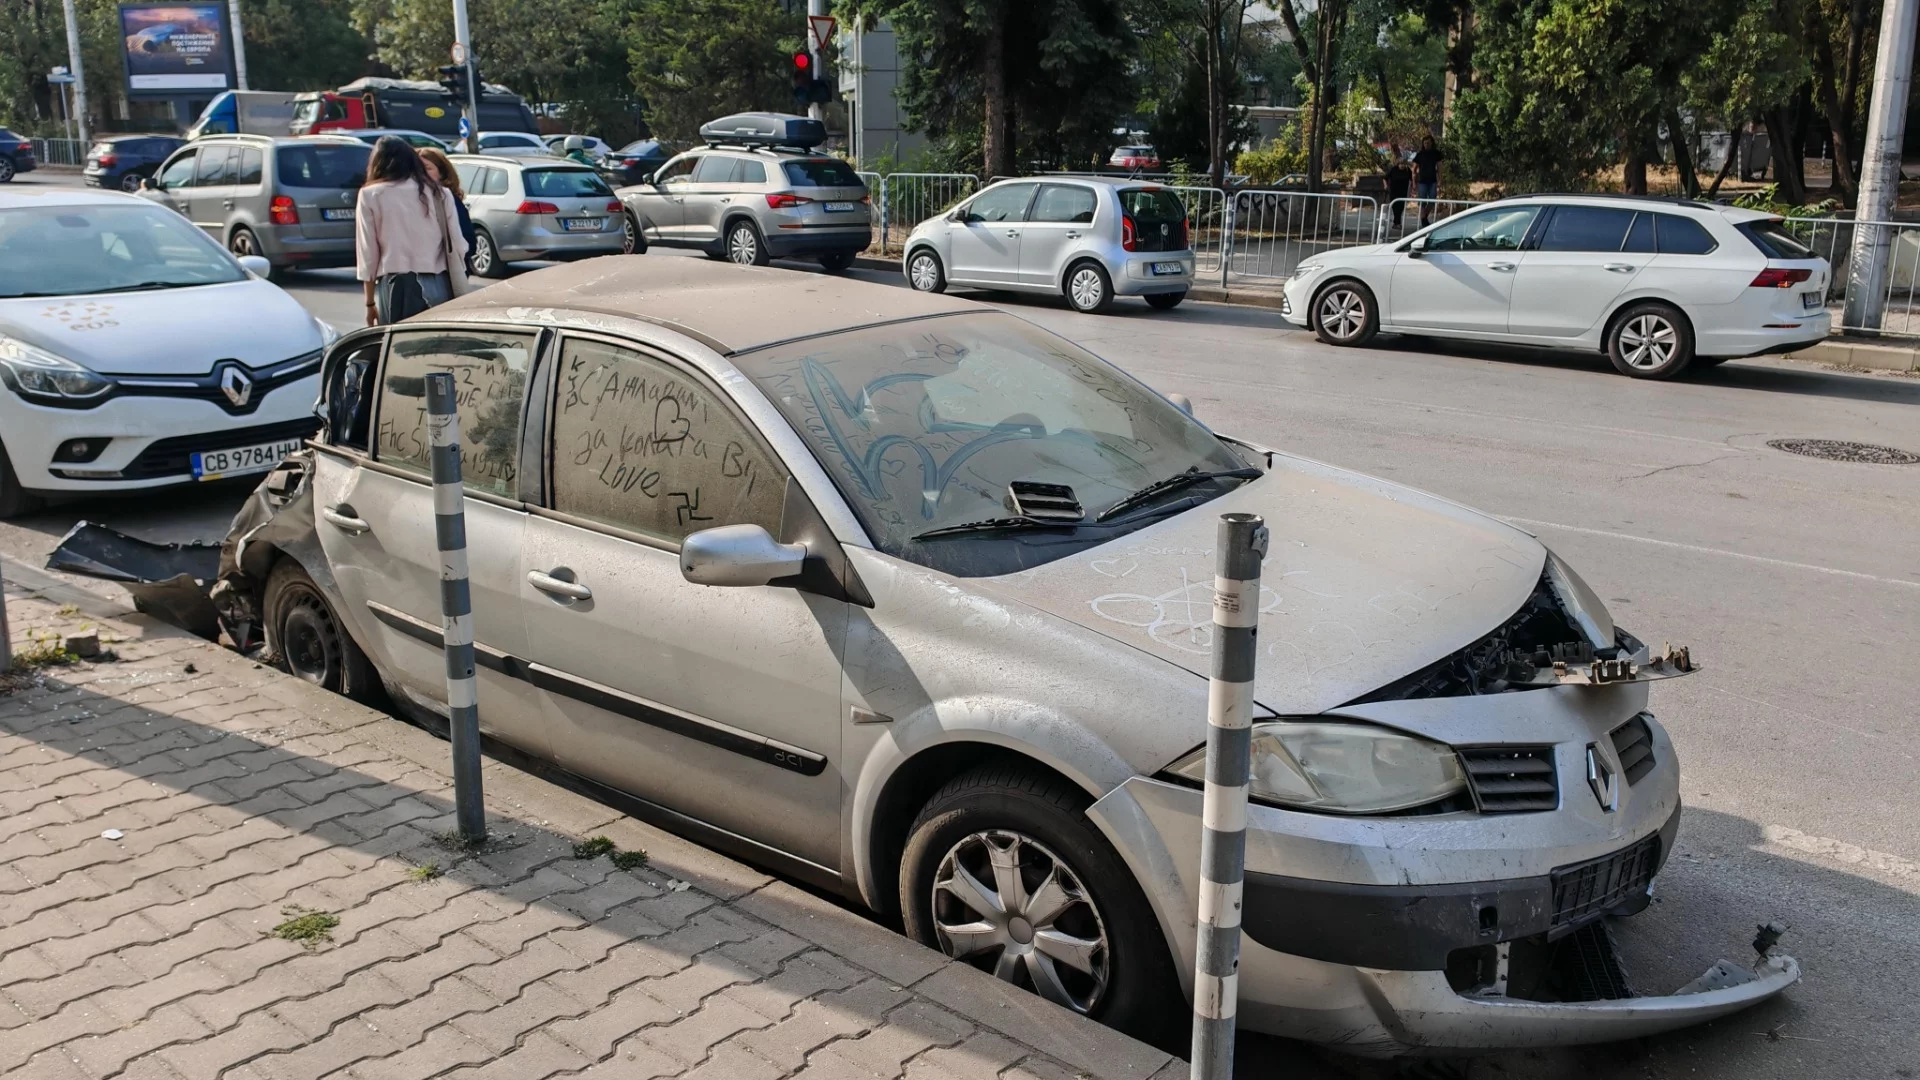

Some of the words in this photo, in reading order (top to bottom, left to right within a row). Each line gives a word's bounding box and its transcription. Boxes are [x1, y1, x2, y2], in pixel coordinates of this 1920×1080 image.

[70, 320, 120, 332] eos
[204, 453, 229, 472] CB
[232, 445, 274, 468] 9784
